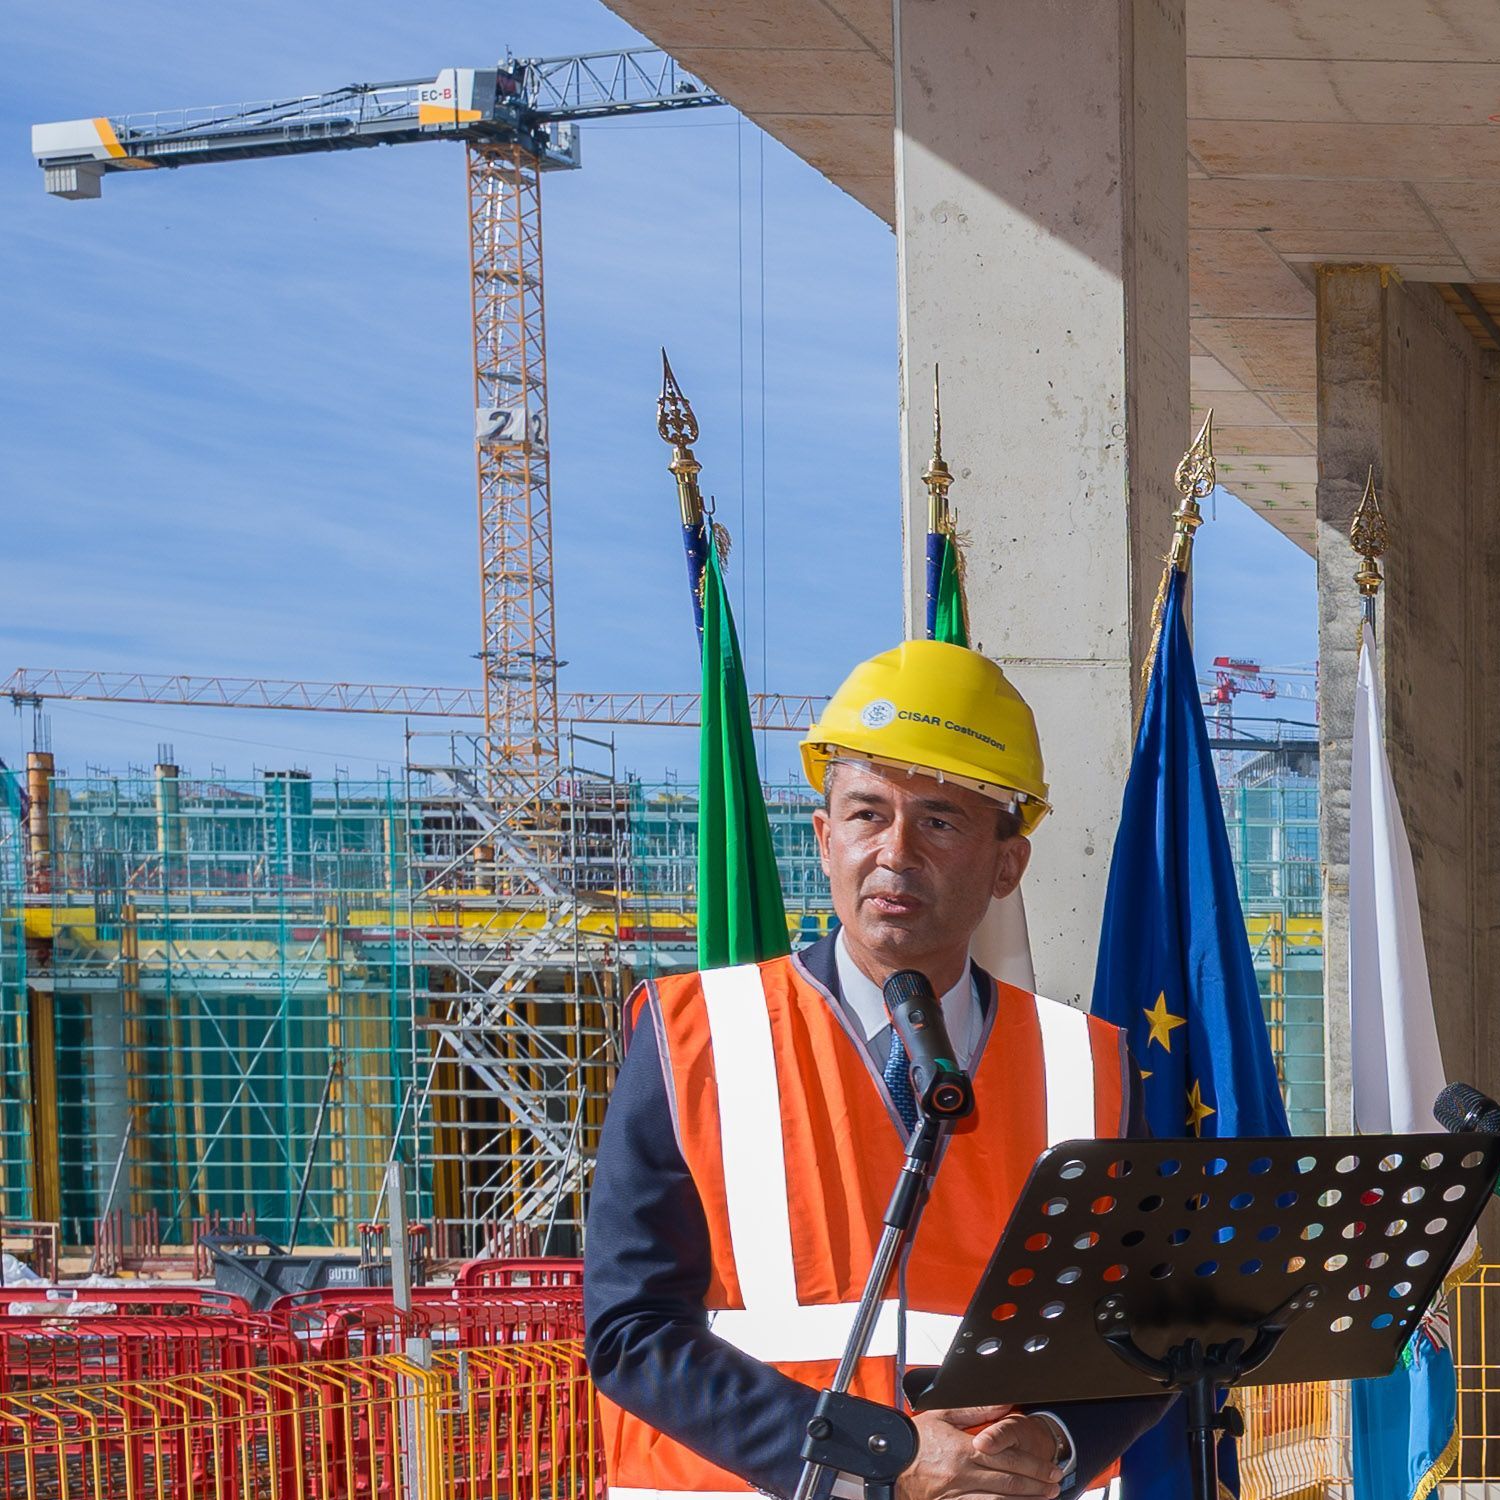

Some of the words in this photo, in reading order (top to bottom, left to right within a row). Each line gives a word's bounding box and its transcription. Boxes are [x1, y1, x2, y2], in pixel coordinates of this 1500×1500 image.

[421, 88, 452, 101] EC-B
[488, 411, 513, 441] 2
[898, 710, 941, 726] CISAR
[944, 720, 1006, 751] Costruzioni
